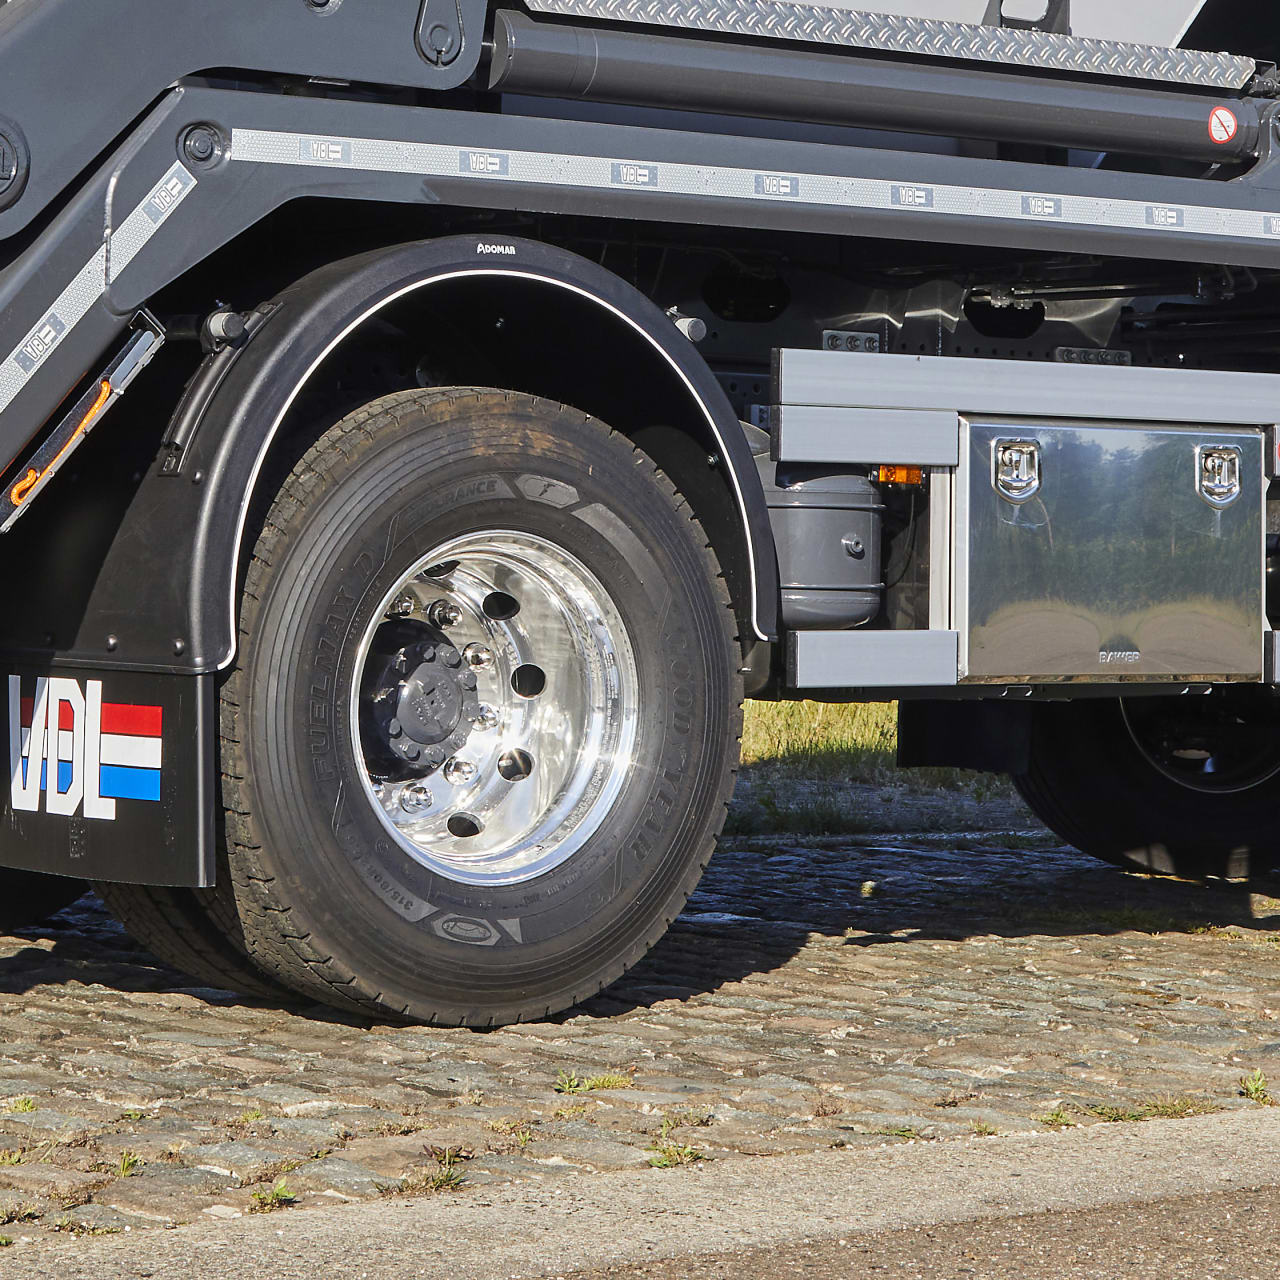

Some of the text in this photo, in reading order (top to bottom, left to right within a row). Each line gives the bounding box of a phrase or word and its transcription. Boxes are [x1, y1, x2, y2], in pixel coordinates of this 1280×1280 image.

[150, 184, 179, 213] VDL
[22, 331, 53, 362] VDL
[310, 585, 355, 781] FUELMAX
[9, 674, 117, 820] VDL
